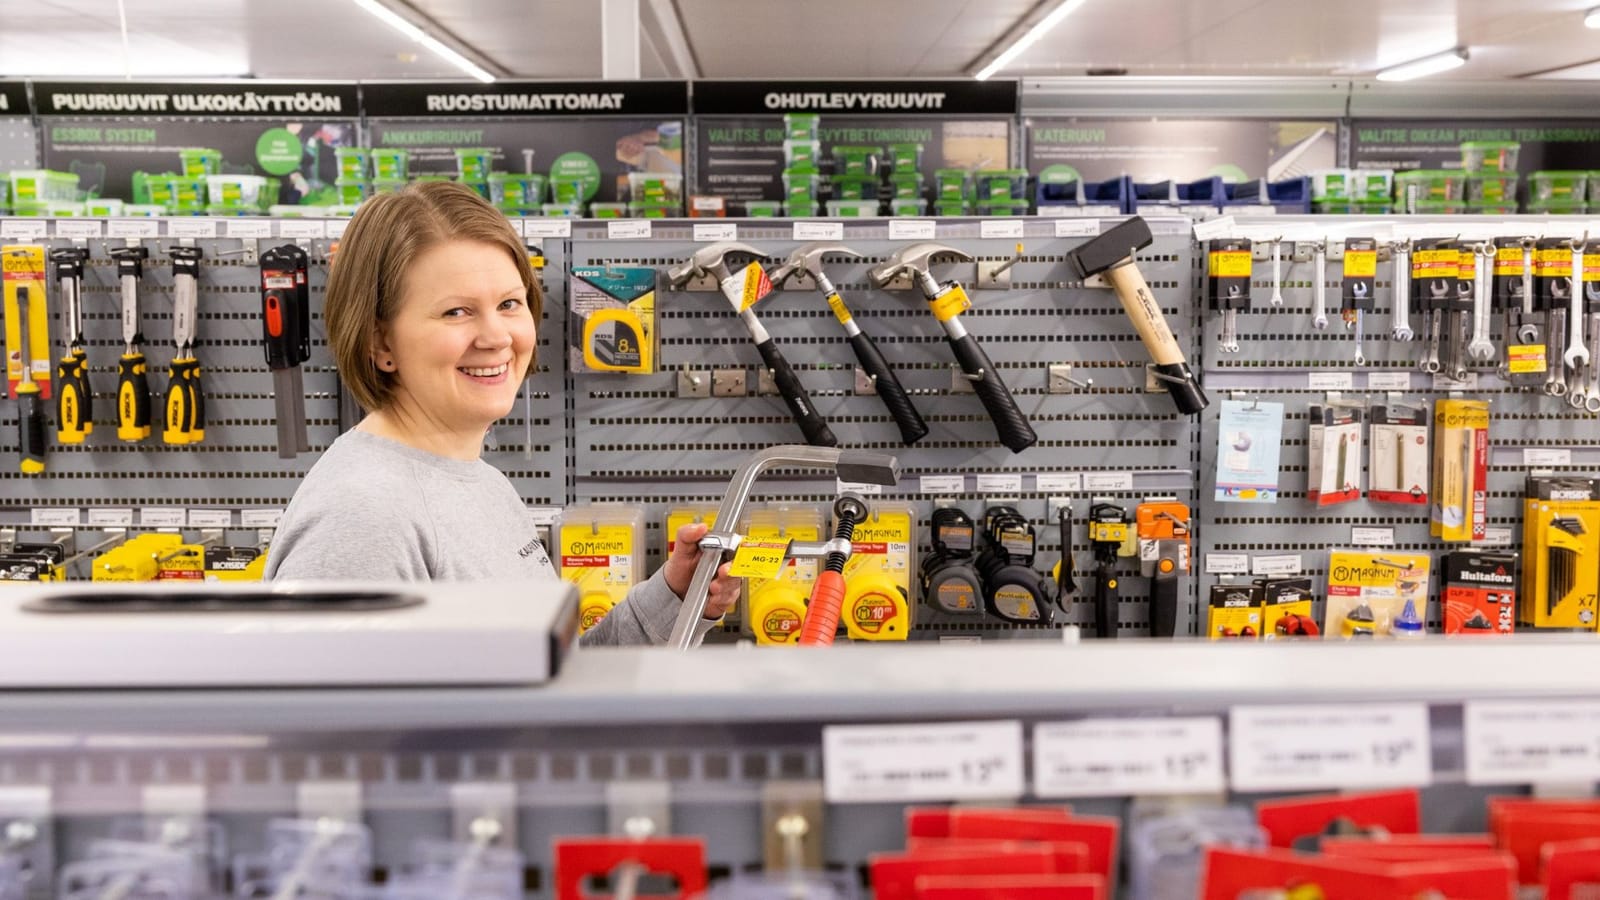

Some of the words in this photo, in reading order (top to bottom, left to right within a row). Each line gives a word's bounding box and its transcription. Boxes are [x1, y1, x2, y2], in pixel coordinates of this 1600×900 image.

[52, 93, 170, 111] PUURUUVIT
[172, 92, 342, 112] ULKOKÄYTTÖÖN
[426, 93, 625, 111] RUOSTUMATTOMAT
[764, 92, 946, 109] OHUTLEVYRUUVIT
[52, 128, 102, 143] ESSBOX
[105, 128, 156, 143] SYSTEM
[382, 129, 484, 144] ANKKURIRUUVIT
[708, 128, 761, 142] VALITSE
[818, 128, 932, 143] EVYTBETONIRUUVI
[1034, 128, 1105, 143] KATERUUVI
[863, 529, 902, 541] MAGNUM
[585, 542, 623, 554] MAGNUM
[1349, 567, 1394, 581] MAGNUM
[1460, 571, 1513, 583] Hultafors
